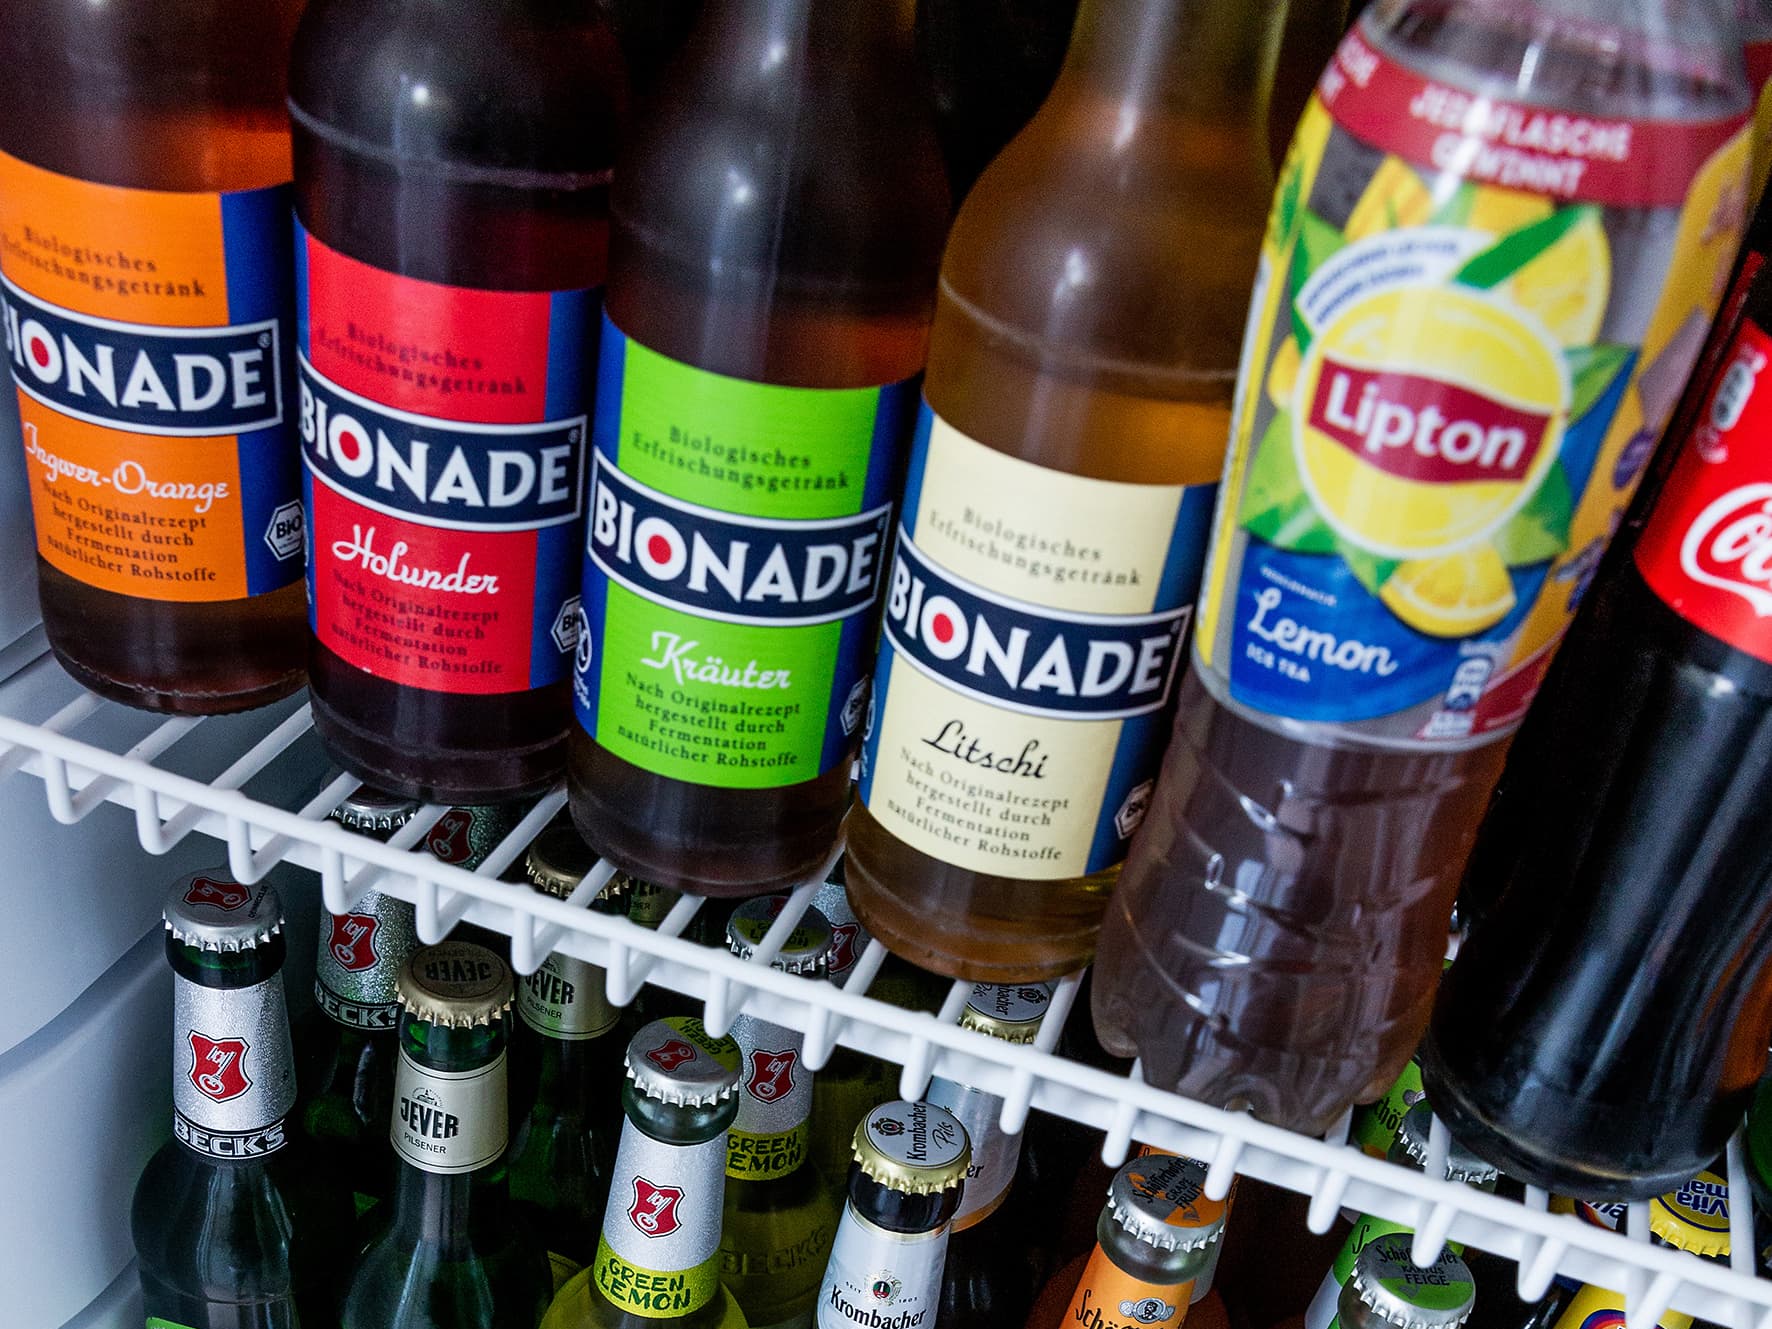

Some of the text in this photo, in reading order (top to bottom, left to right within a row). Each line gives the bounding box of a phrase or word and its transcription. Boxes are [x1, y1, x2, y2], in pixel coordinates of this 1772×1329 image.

[1431, 132, 1587, 196] GWINNT
[23, 226, 158, 273] Biologisches
[2, 303, 267, 412] BIONADE
[298, 377, 570, 508] BIONADE
[1324, 372, 1528, 471] Lipton
[24, 421, 229, 513] Ingwer-Orange
[632, 431, 849, 493] Erfrischungsgetränk
[669, 425, 811, 469] Biologisches
[52, 503, 195, 547] hergestellt durch
[77, 496, 207, 532] Originalrezept
[962, 506, 1103, 562] Biologisches
[47, 535, 217, 584] natürlicher Rohstoffe
[66, 525, 179, 566] Fermentation
[331, 523, 499, 594] Holunder
[593, 480, 878, 604] BIONADE
[929, 509, 1142, 587] Erfrischungsgetränk
[432, 620, 485, 641] durch
[888, 554, 1171, 698] BIONADE
[1247, 587, 1398, 677] Lemon
[641, 630, 793, 690] Kräuter
[1278, 656, 1311, 683] TEA
[626, 672, 801, 719] Nach Originalrezept
[635, 696, 786, 736] hergestellt durch
[617, 724, 799, 768] natürlicher Rohstoffe
[648, 719, 767, 752] Fermentation
[921, 719, 1048, 779] Litschi
[900, 747, 1070, 810] Nach Originalrezept
[906, 770, 1052, 827] hergestellt durch
[886, 800, 1063, 861] natürlicher Rohstoffe
[914, 796, 1031, 841] Fermentation
[525, 972, 574, 1005] JEVER
[526, 995, 563, 1019] PILSENER
[174, 1111, 288, 1157] BECK'S
[400, 1095, 460, 1140] JEVER
[905, 1101, 928, 1163] Krombacher
[934, 1117, 955, 1152] Pils
[404, 1131, 447, 1154] PILSENER
[727, 1131, 800, 1156] GREEN
[727, 1148, 801, 1174] EMON
[600, 1264, 691, 1310] LEMON
[607, 1257, 685, 1292] GREEN
[845, 1281, 862, 1295] SEIT
[1405, 1273, 1451, 1287] FEIGE
